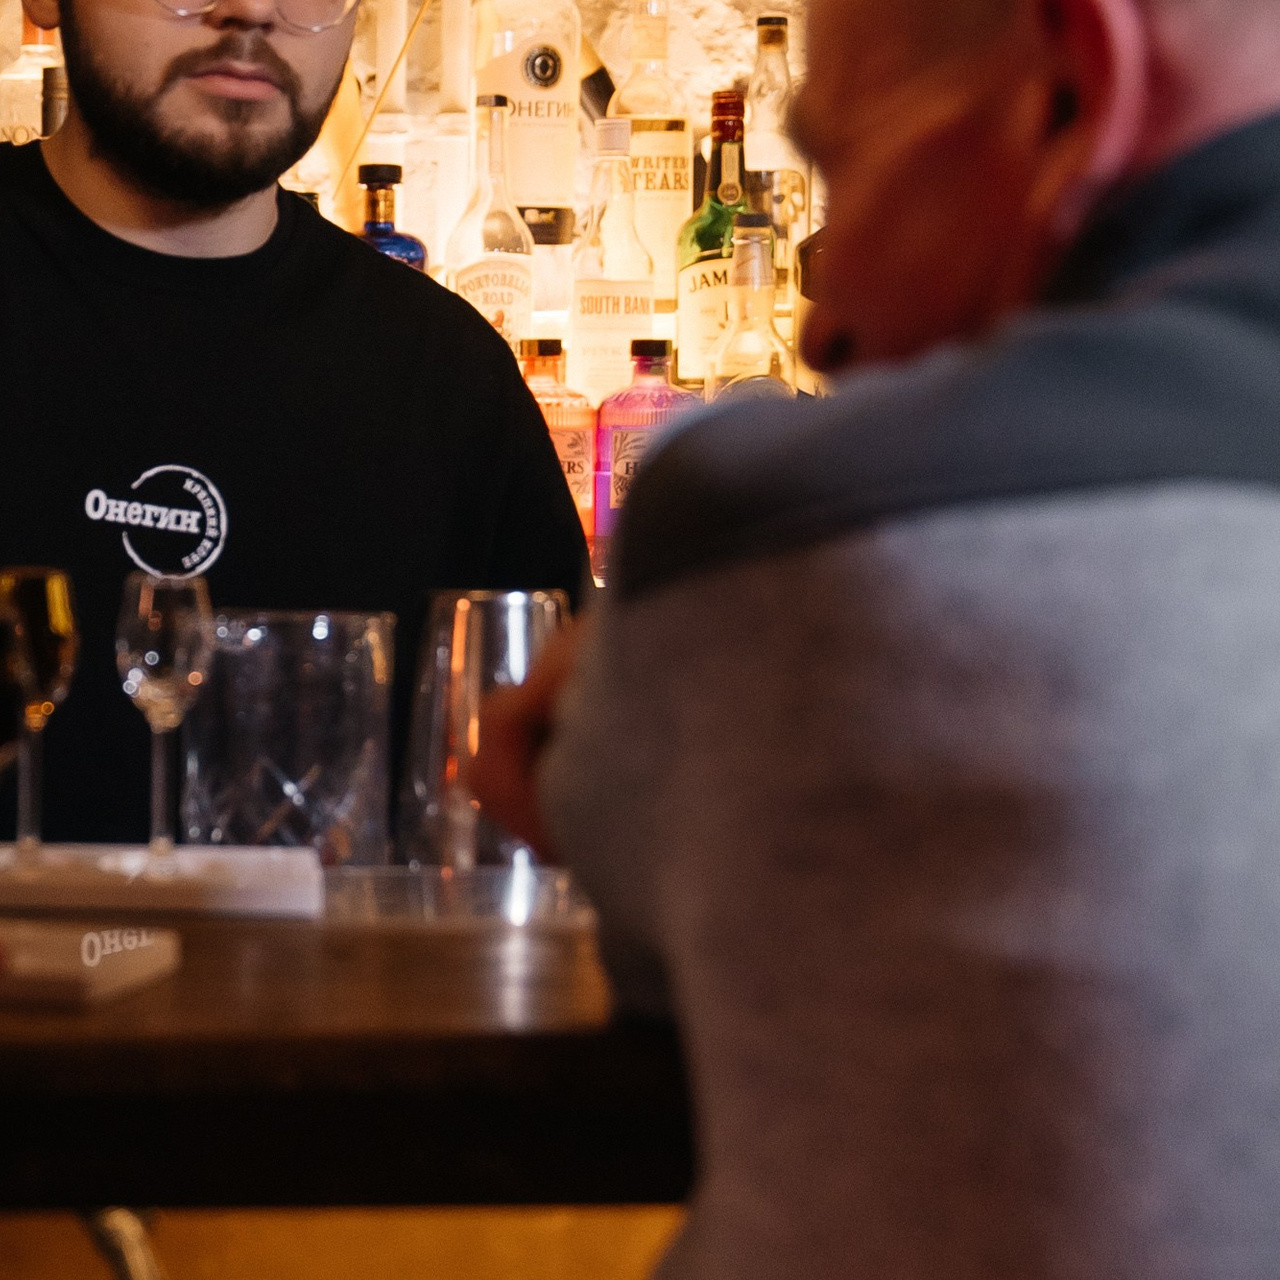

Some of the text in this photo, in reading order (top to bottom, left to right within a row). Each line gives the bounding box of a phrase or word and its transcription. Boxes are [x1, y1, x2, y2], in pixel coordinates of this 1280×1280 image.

[632, 172, 689, 190] TEARS
[482, 291, 513, 305] ROAD
[580, 295, 619, 314] SOUTH
[85, 488, 201, 534] Онегин
